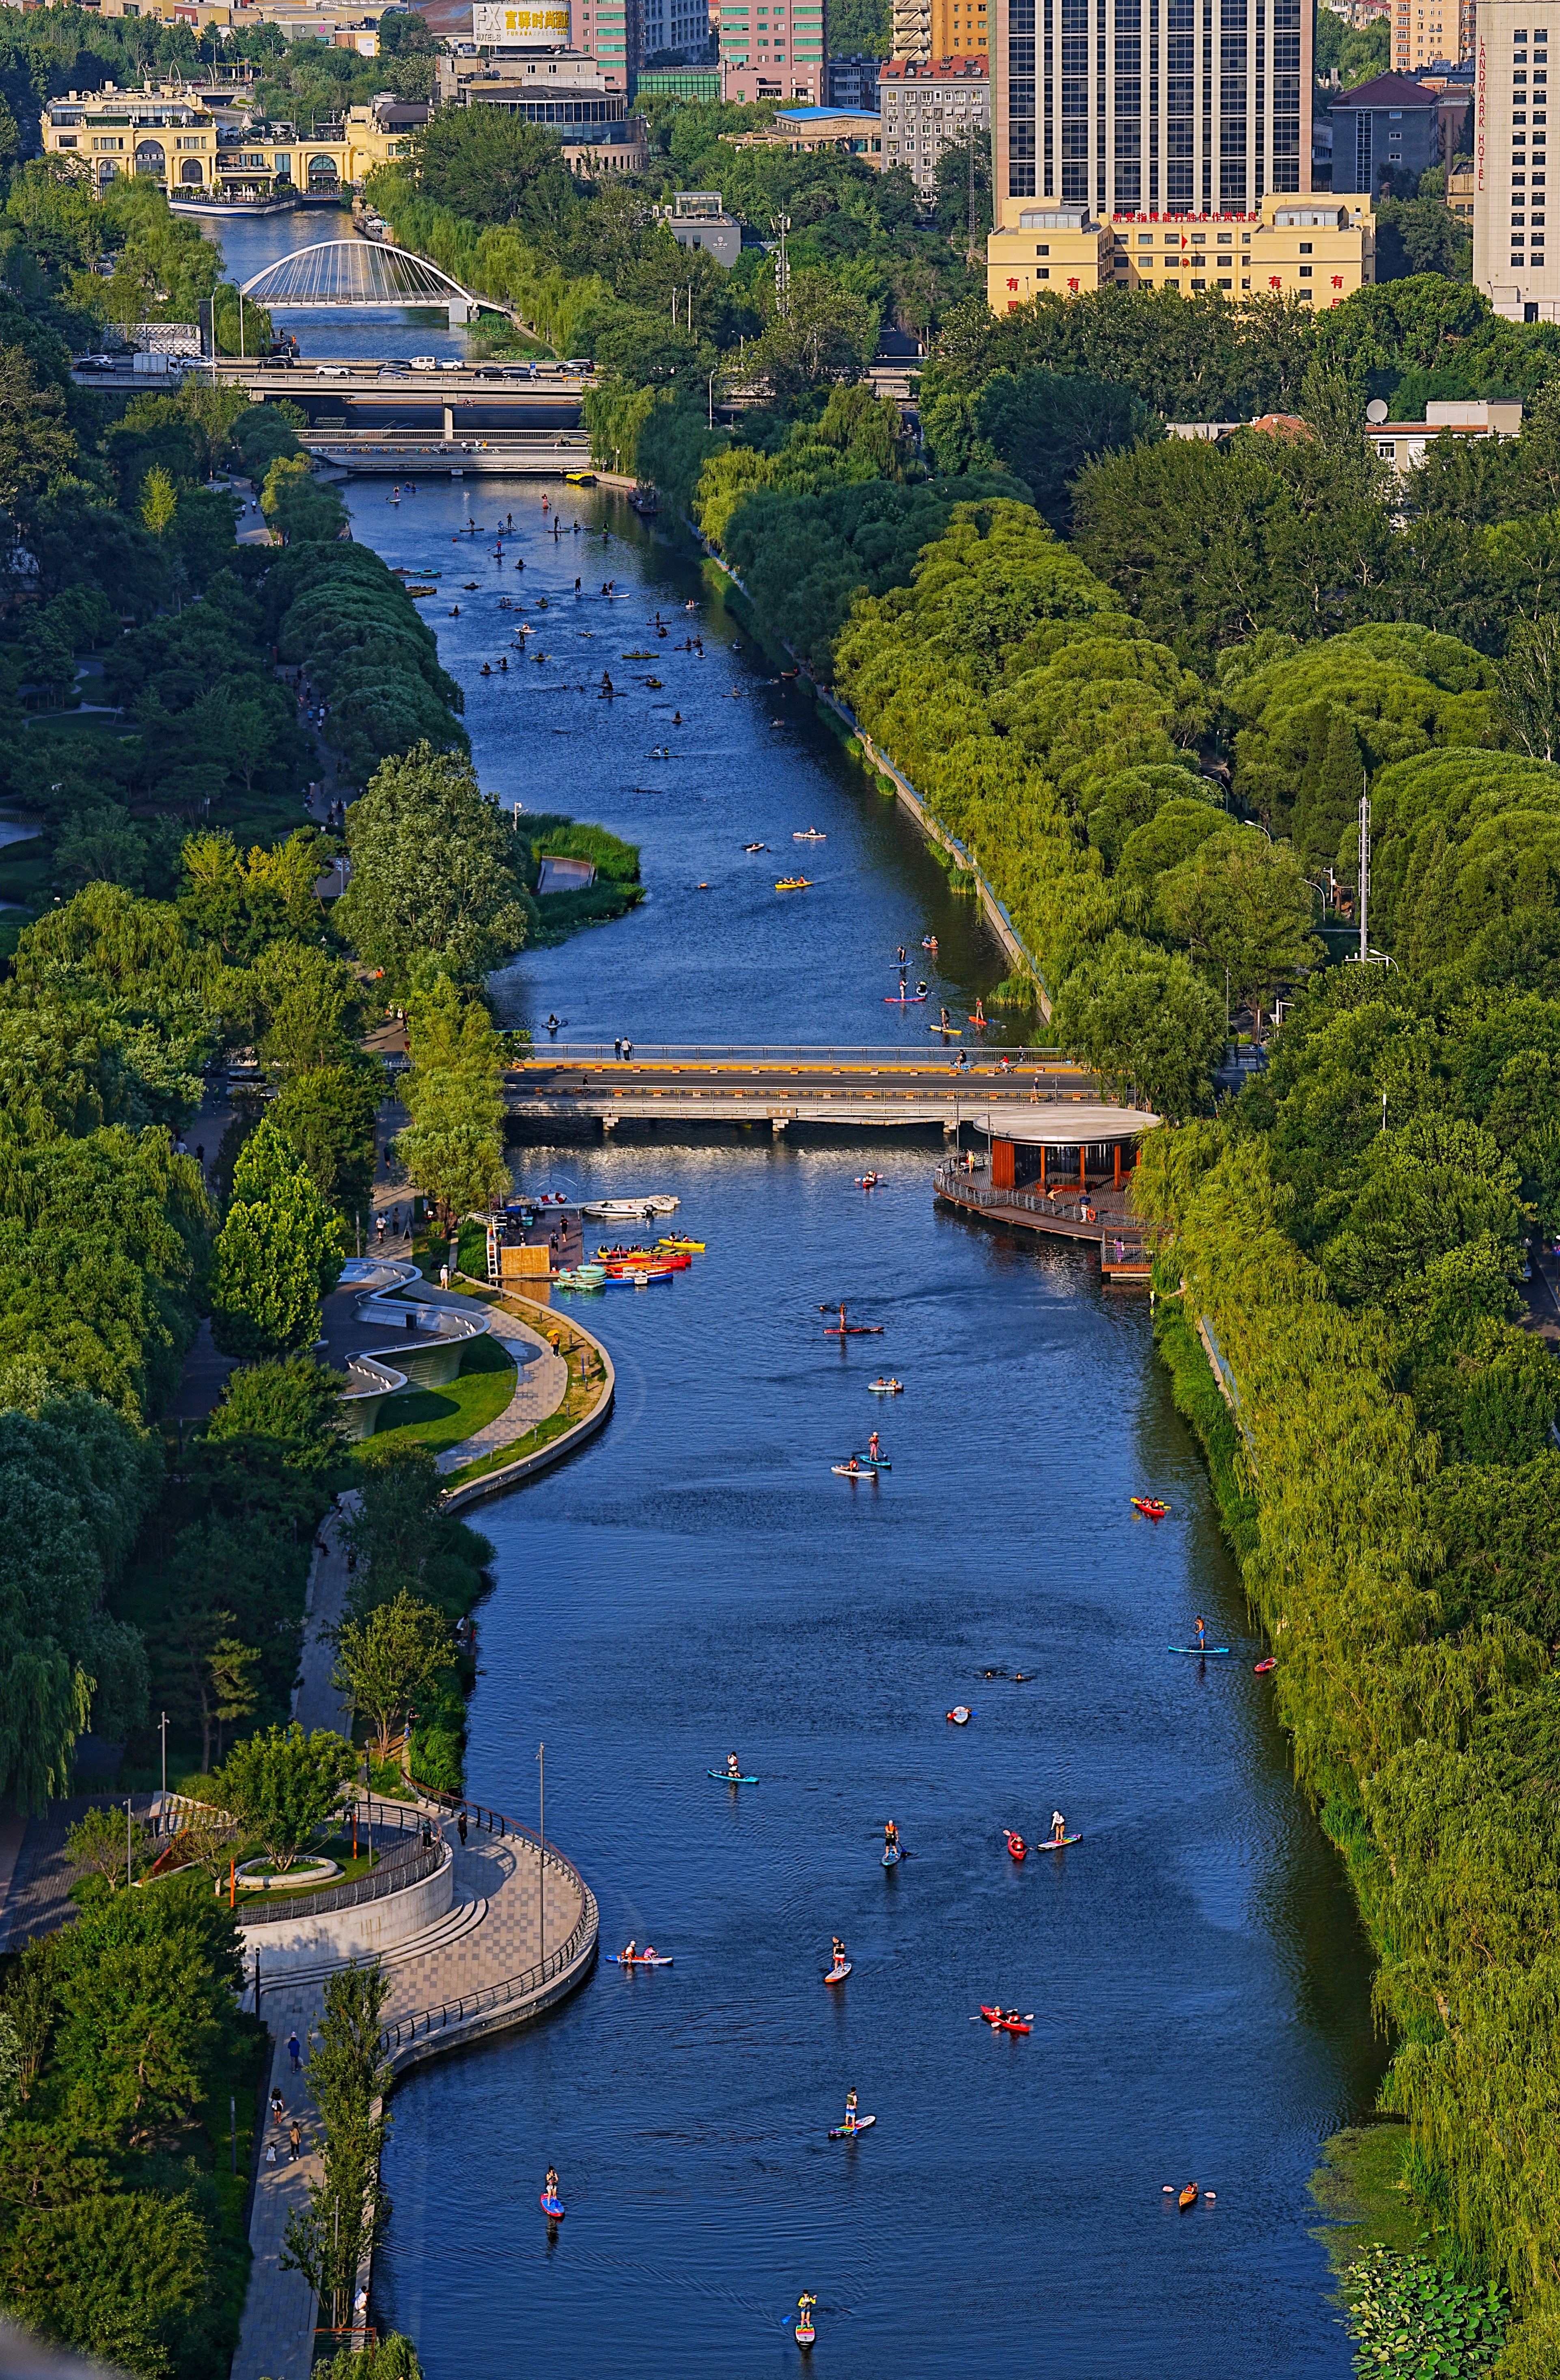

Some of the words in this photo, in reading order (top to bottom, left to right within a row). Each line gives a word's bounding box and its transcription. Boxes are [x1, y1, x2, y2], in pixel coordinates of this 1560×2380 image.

[476, 6, 501, 30] FX
[505, 11, 569, 29] 富驿时尚酒店
[476, 33, 501, 41] HOTELS
[1478, 35, 1487, 127] LANDMARK
[1113, 211, 1257, 223] 听党指挥能打胜仗作风优良
